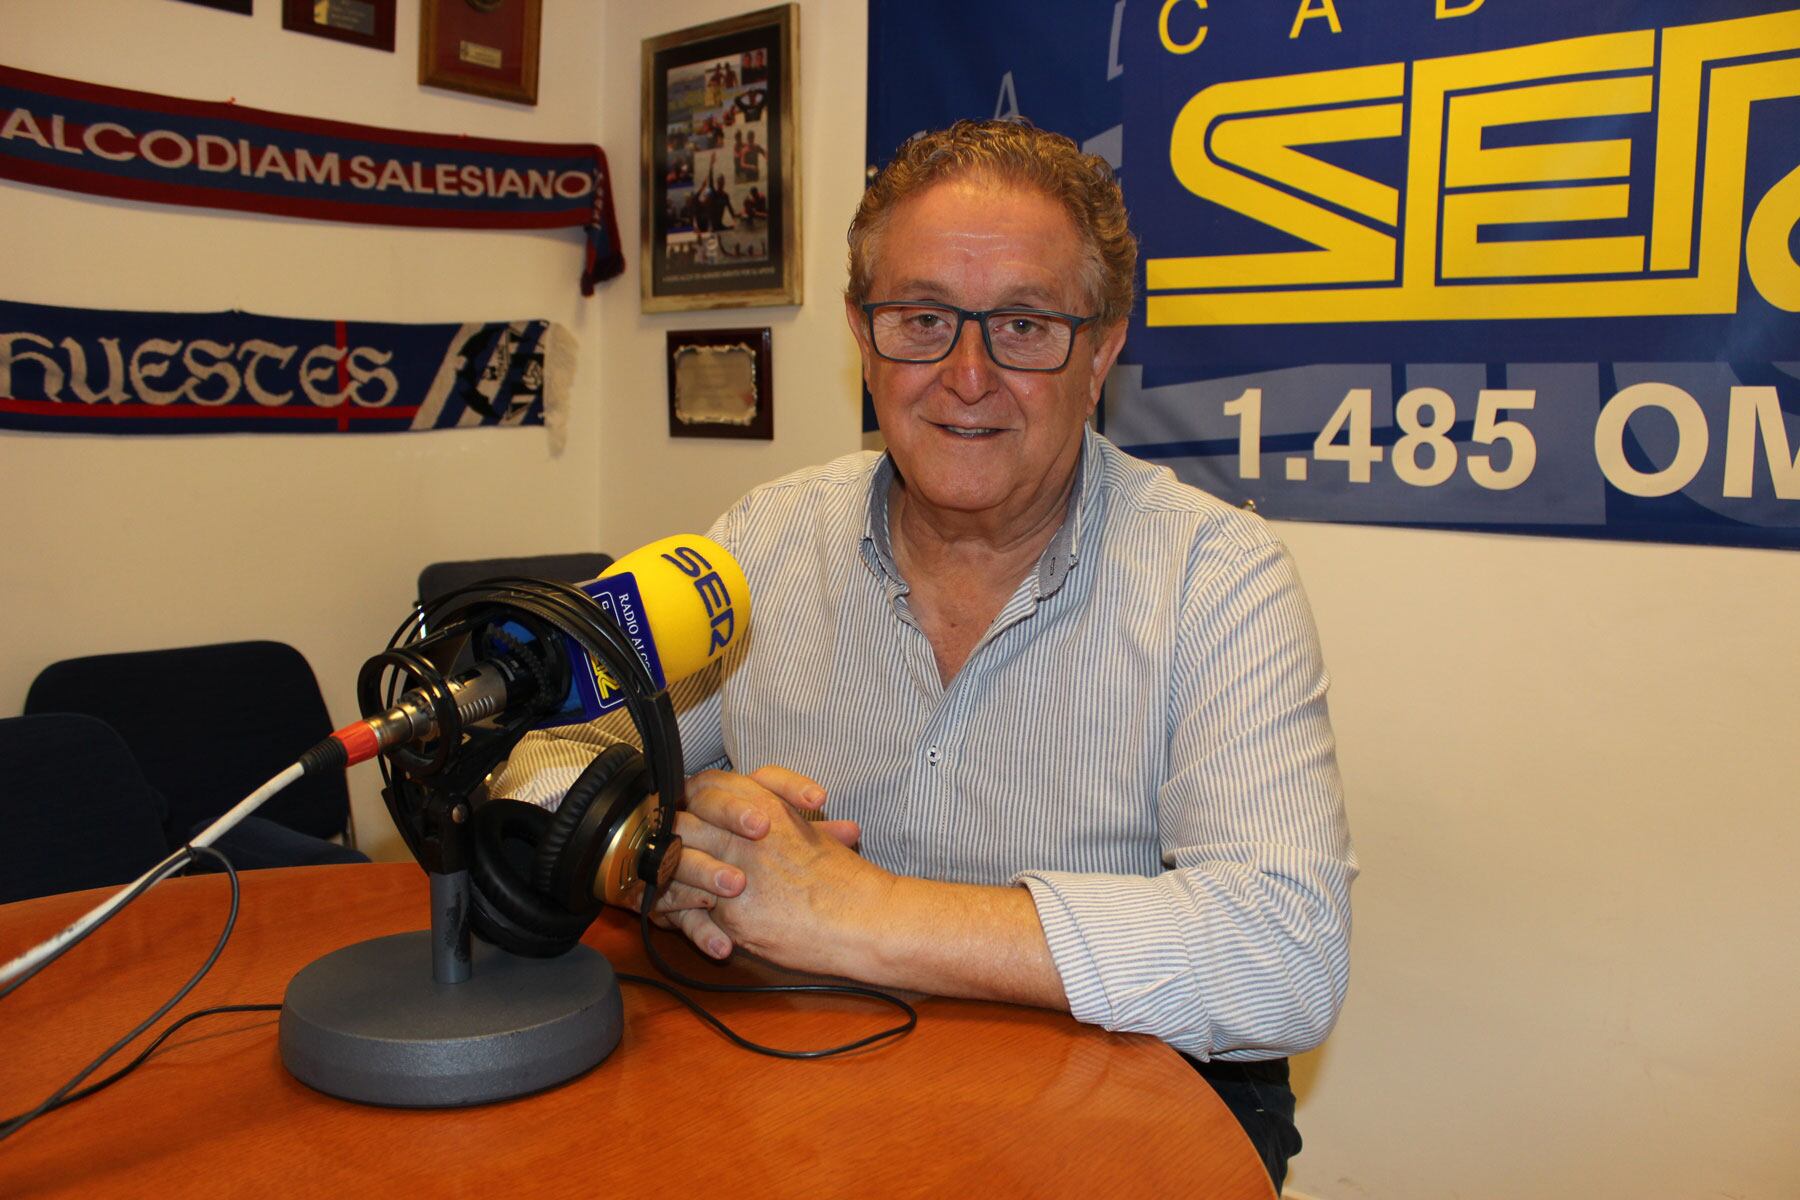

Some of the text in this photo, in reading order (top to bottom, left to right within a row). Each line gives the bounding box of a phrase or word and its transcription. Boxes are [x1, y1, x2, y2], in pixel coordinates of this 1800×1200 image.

[1, 107, 341, 187] ALCODIAM
[350, 156, 592, 199] SALESIANO
[1223, 386, 1537, 490] 1.485
[618, 593, 640, 635] RADIO
[660, 546, 735, 657] SER
